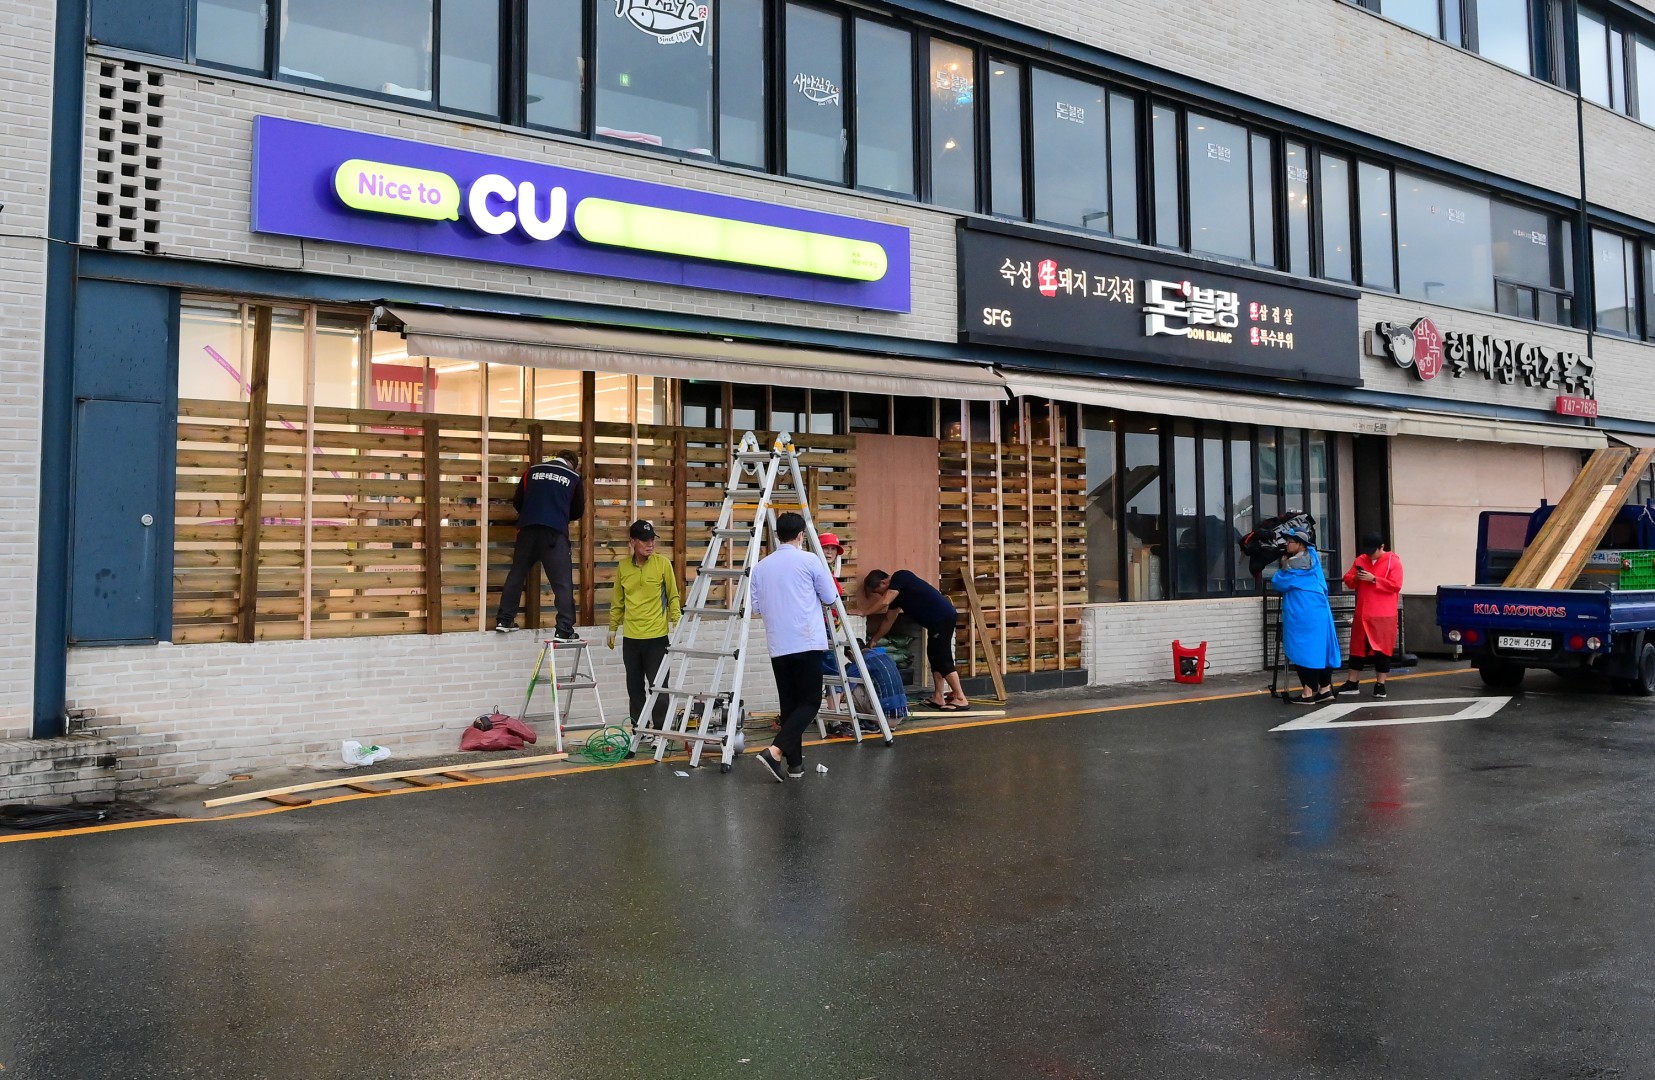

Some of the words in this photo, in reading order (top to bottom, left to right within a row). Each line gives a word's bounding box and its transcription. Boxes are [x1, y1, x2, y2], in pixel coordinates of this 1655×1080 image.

[358, 172, 412, 201] Nice
[417, 183, 441, 205] to
[468, 173, 568, 241] CU
[1000, 258, 1031, 289] 숙성
[1092, 275, 1134, 304] 고깃집
[983, 307, 1012, 328] SFG
[1143, 279, 1240, 336] 돈블랑
[1187, 328, 1205, 340] DON
[1206, 330, 1233, 344] BLANC
[376, 380, 424, 404] WINE
[1563, 400, 1597, 415] 747-7625
[1474, 603, 1500, 615] KIA
[1503, 604, 1567, 618] MOTORS
[1524, 639, 1547, 648] 4894
